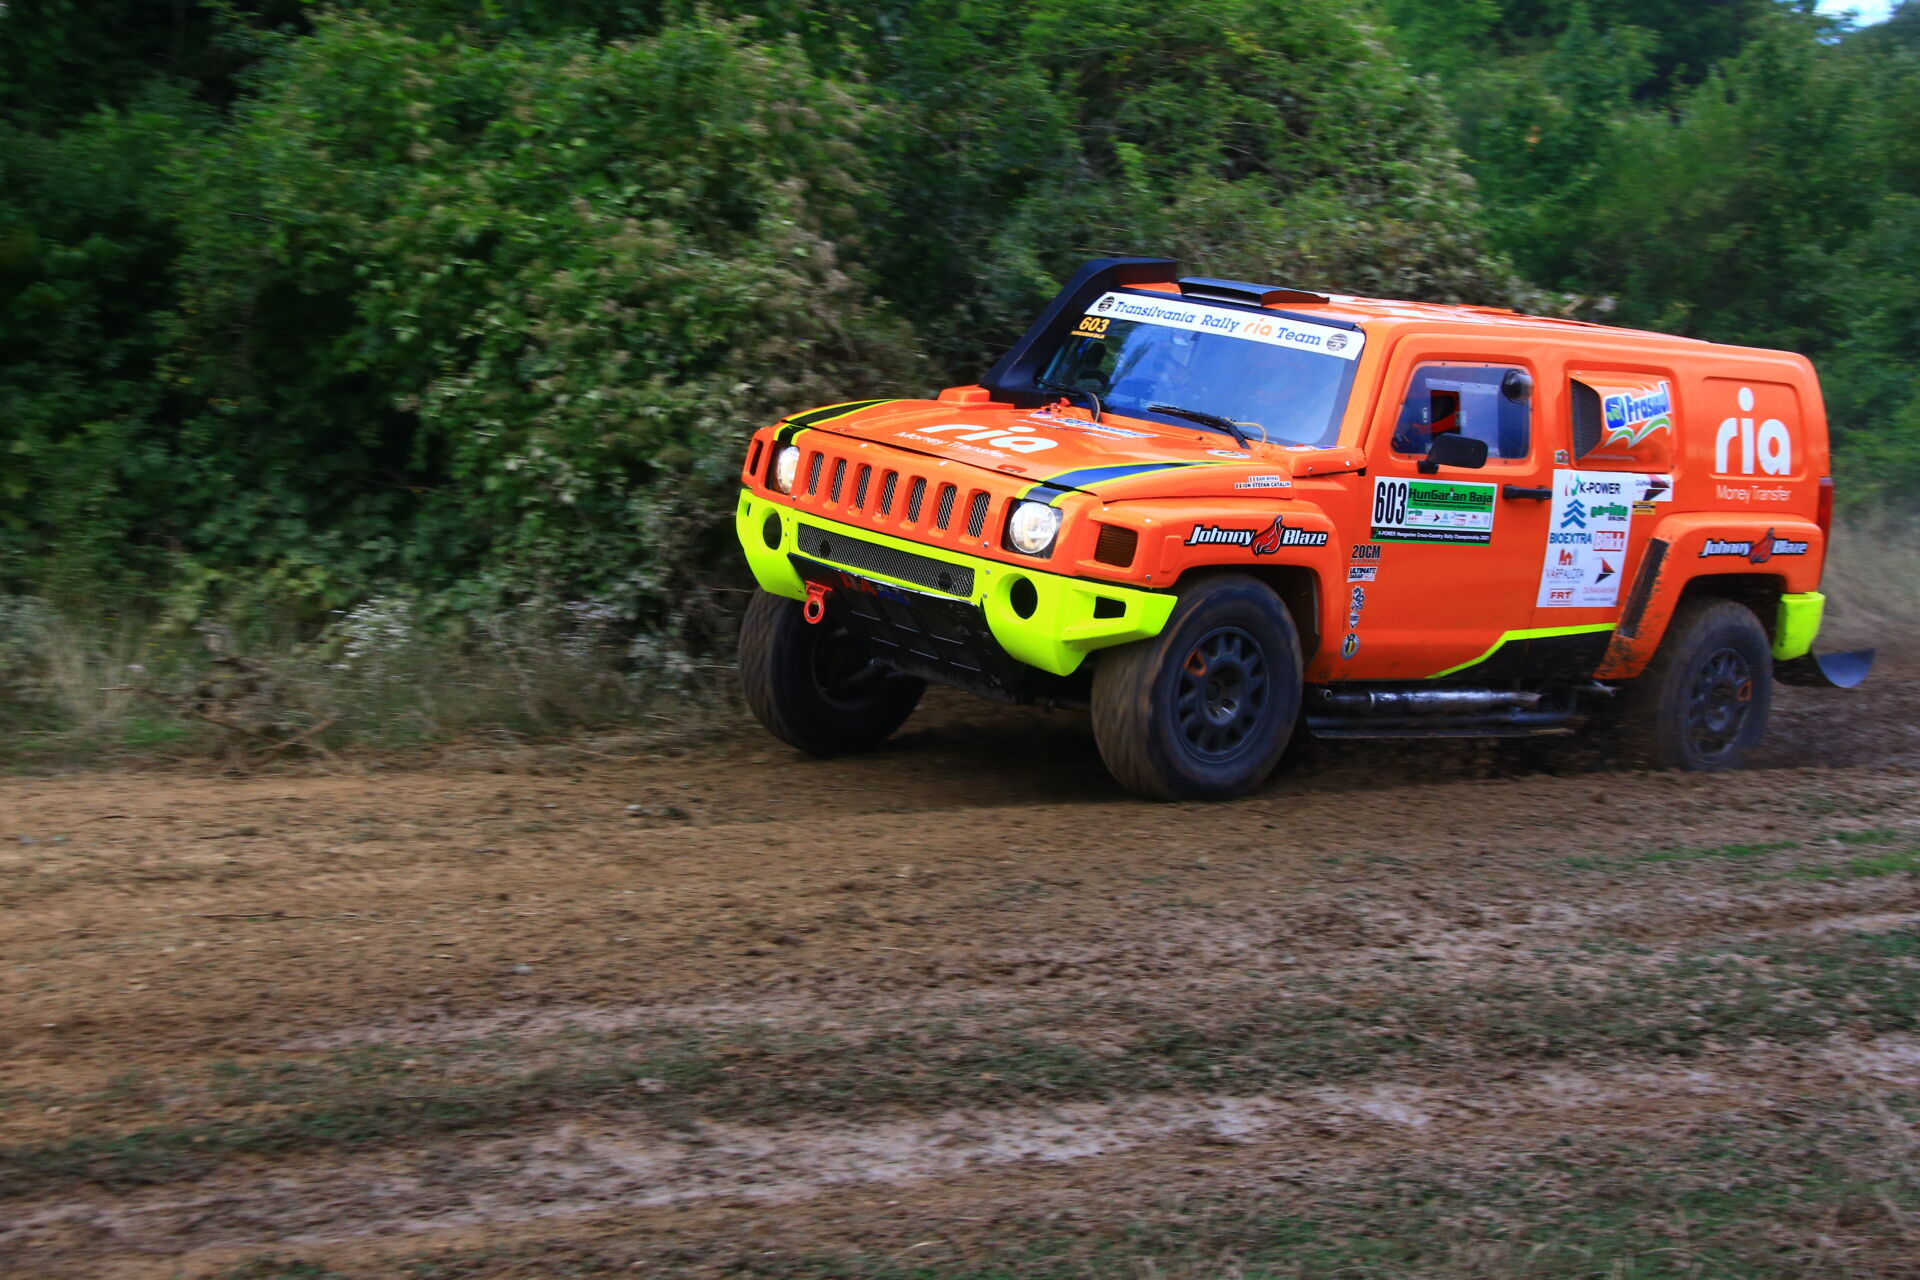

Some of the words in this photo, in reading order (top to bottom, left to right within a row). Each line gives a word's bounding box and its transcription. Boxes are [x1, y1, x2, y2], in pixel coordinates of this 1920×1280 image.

[1079, 316, 1110, 333] 603
[1113, 301, 1196, 324] Transilvania
[1200, 314, 1240, 333] Rally
[1243, 317, 1273, 338] ria
[1276, 327, 1321, 346] Team
[916, 424, 1058, 454] ria
[1715, 387, 1791, 475] ria
[894, 431, 949, 446] Money
[947, 441, 1012, 459] Transfer
[1580, 482, 1621, 494] K-POWER
[1716, 485, 1751, 503] Money
[1752, 486, 1792, 501] Transfer
[1374, 481, 1408, 524] 603
[1469, 491, 1493, 505] Baja
[1184, 526, 1256, 546] Johnny
[1282, 528, 1328, 546] Blaze
[1549, 532, 1593, 545] BIOEXTRA
[1352, 544, 1381, 559] 20CM
[1699, 539, 1752, 557] Johnny
[1771, 539, 1809, 555] Blaze
[1550, 591, 1573, 599] FRT
